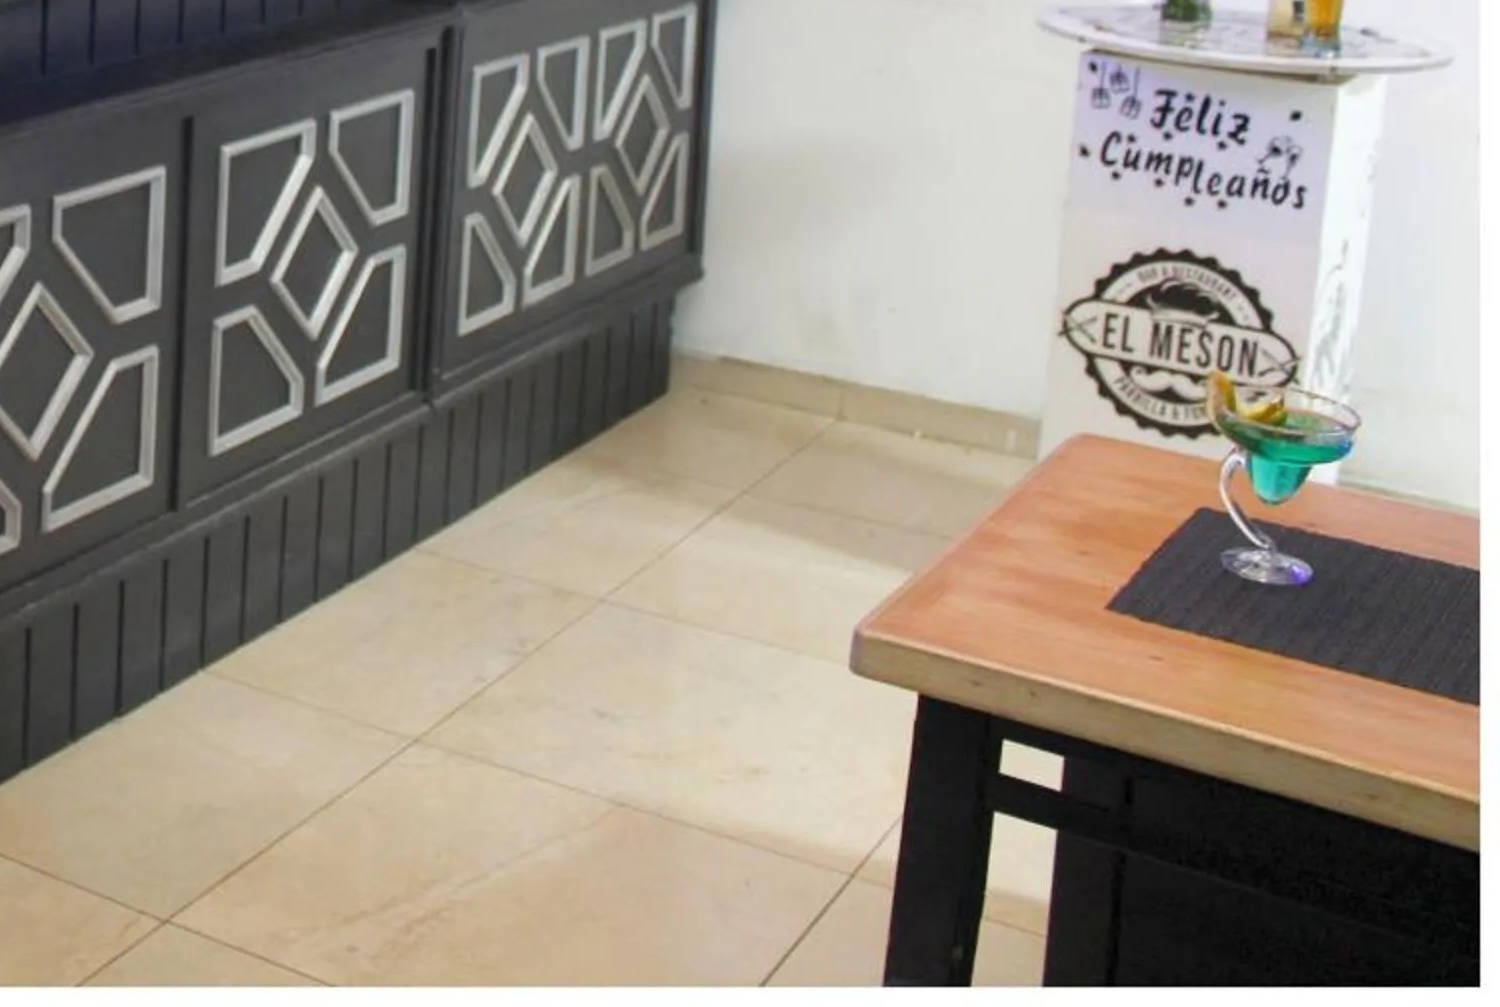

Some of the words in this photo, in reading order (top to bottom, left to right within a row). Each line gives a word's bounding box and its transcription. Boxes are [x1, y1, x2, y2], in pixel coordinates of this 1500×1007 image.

[1150, 89, 1251, 145] Feliz
[1100, 130, 1306, 210] Cumpleaños
[1102, 312, 1135, 353] EL
[1149, 321, 1259, 377] MESON
